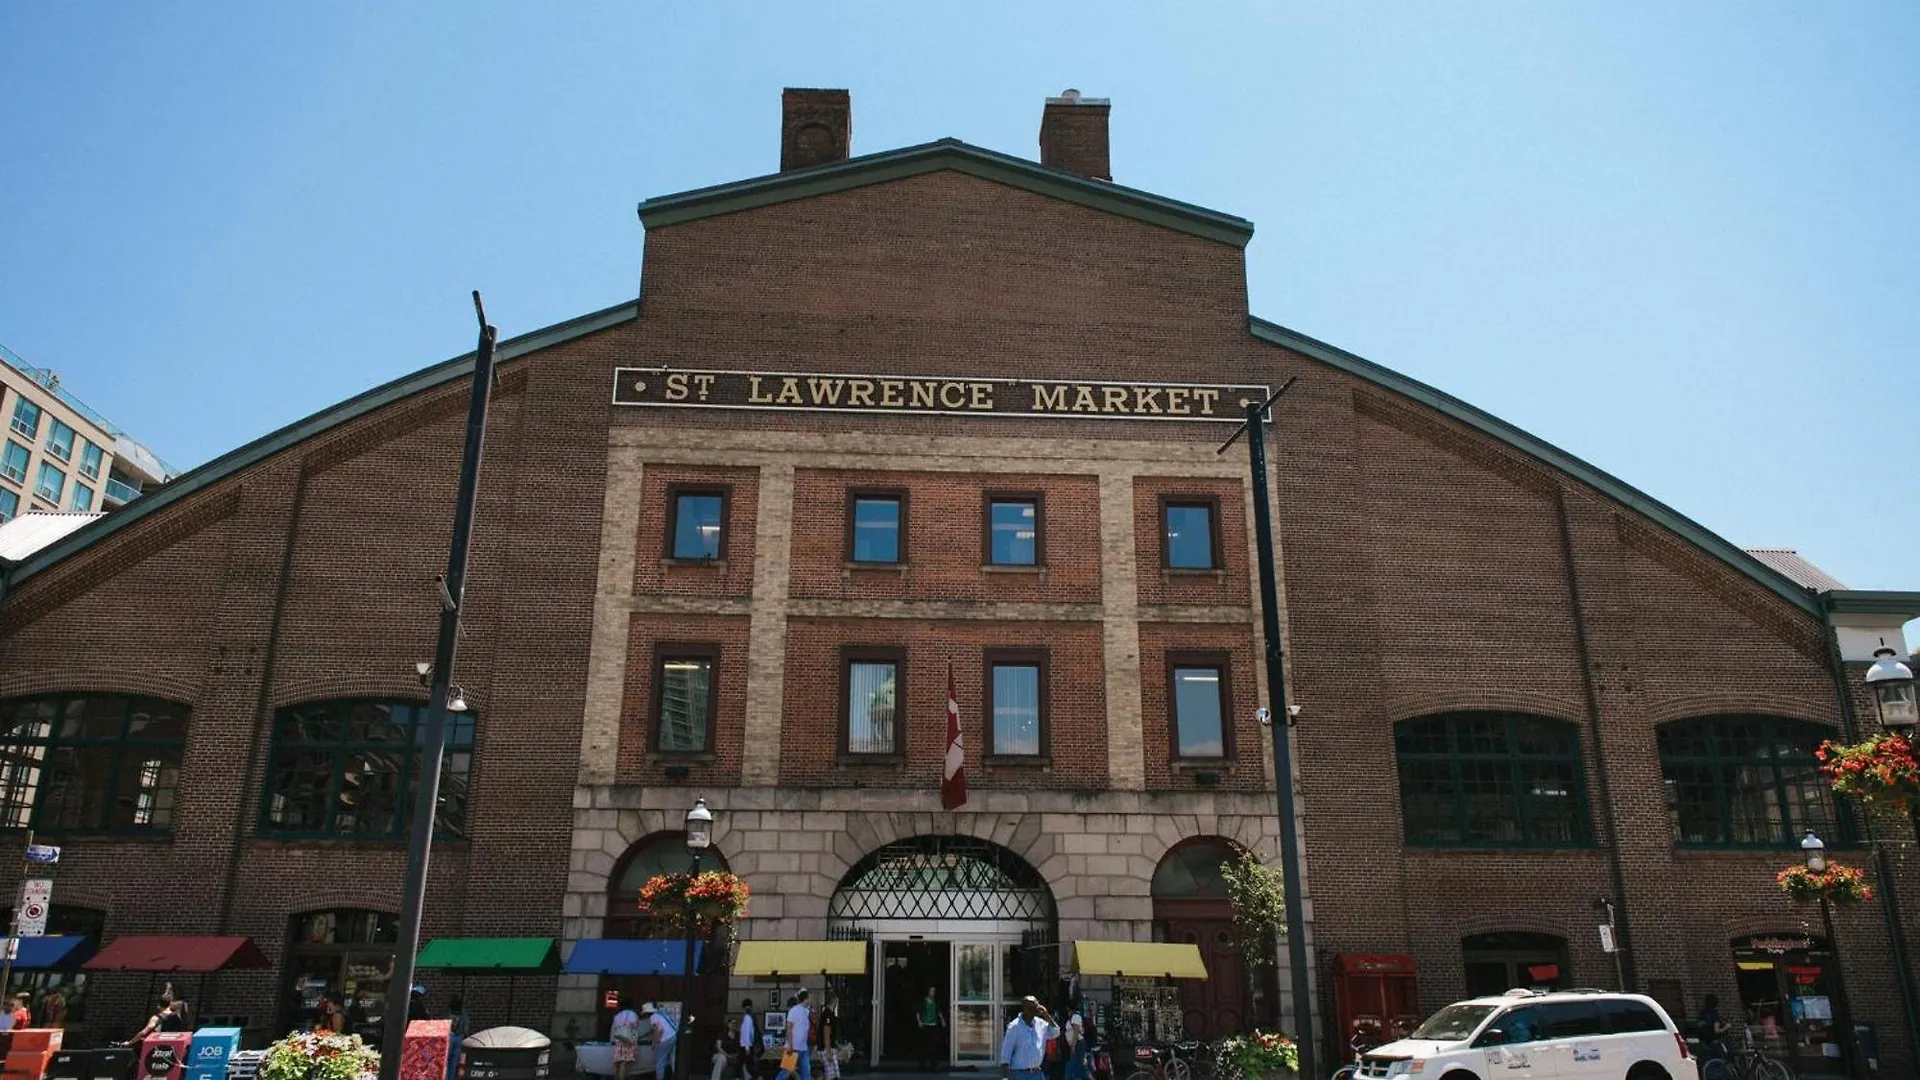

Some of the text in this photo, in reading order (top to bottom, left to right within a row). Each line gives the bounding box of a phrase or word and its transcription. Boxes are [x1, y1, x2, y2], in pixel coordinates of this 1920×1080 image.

[665, 374, 1219, 414] ST LAWRENCE MARKET
[197, 1046, 223, 1056] JOB
